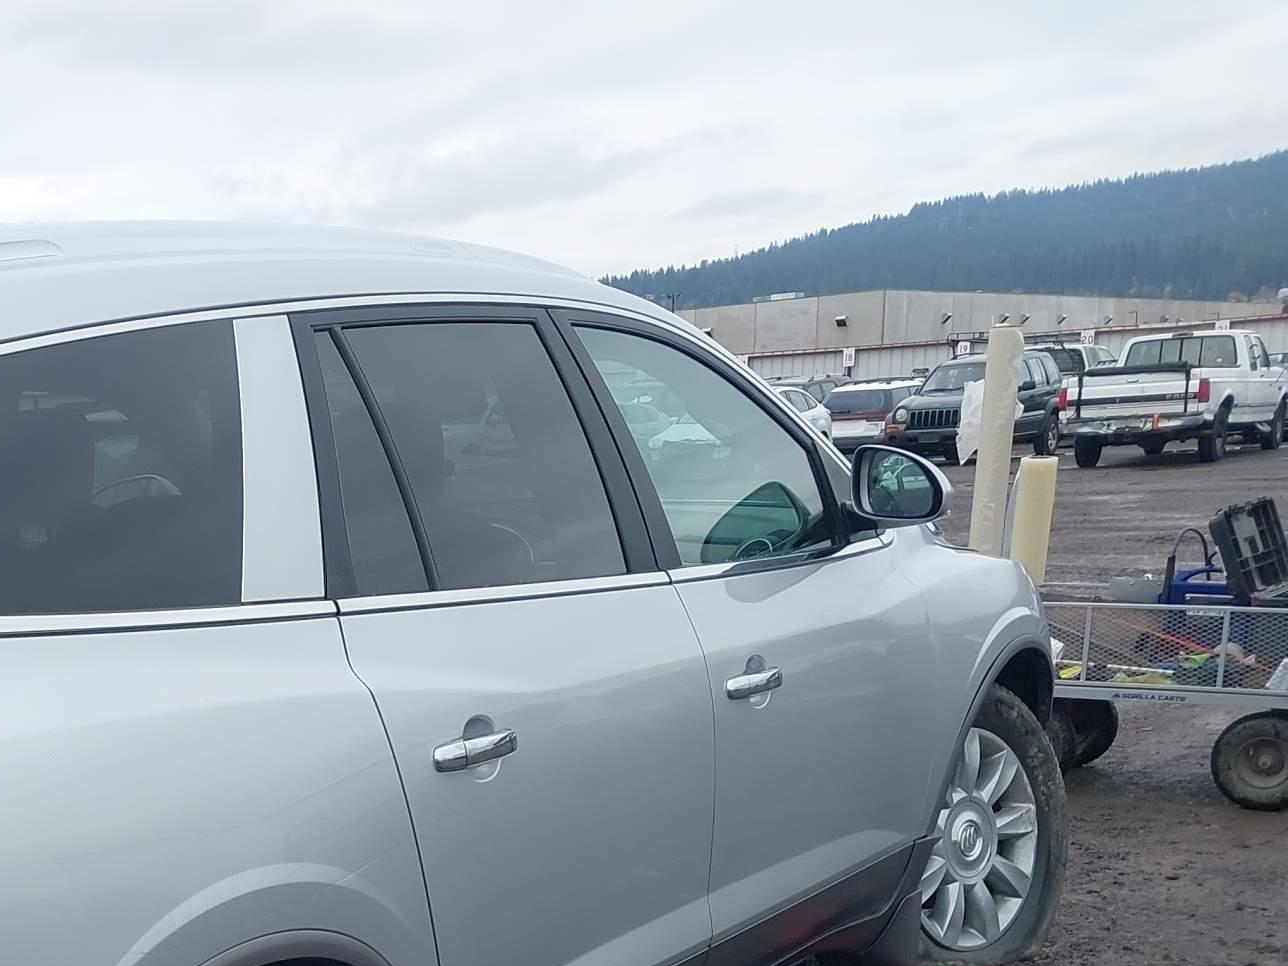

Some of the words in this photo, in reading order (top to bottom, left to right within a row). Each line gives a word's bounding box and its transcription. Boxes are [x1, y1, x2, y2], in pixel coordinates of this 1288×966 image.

[1081, 335, 1094, 345] 20
[959, 344, 968, 353] 19
[844, 352, 853, 362] 18
[1122, 693, 1156, 701] GORILLA
